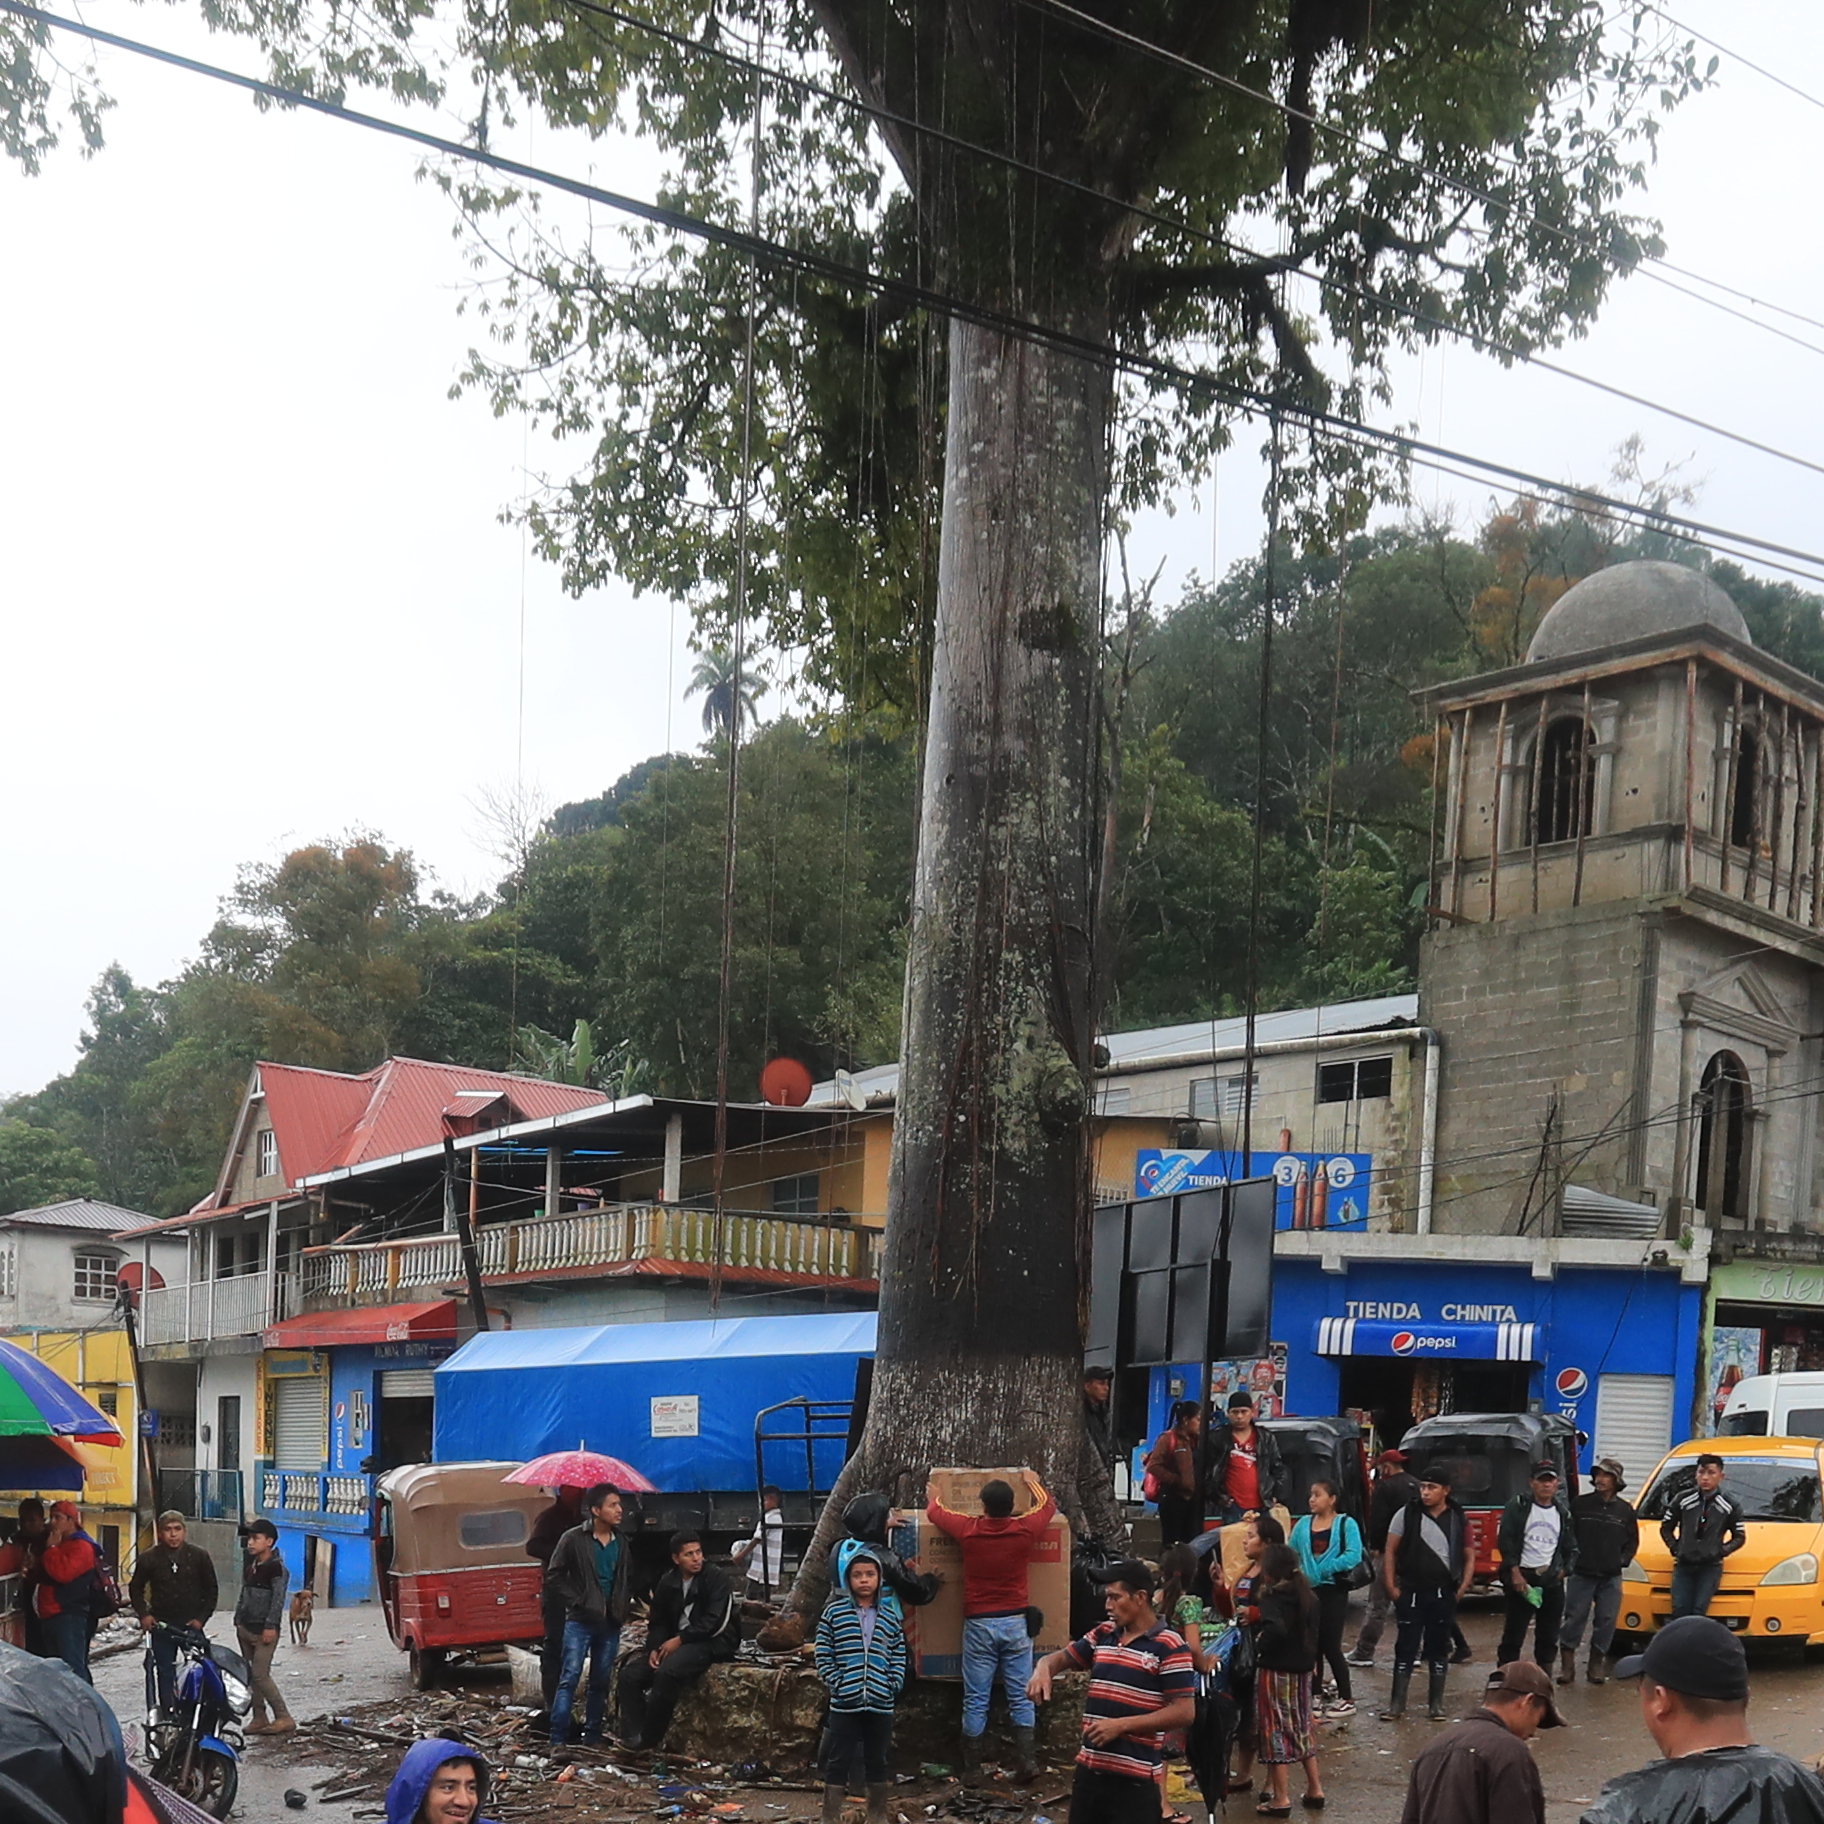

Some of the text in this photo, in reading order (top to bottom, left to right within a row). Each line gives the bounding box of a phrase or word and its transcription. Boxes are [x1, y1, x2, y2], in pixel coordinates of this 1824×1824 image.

[1187, 1175, 1228, 1187] TIENDA
[1346, 1301, 1518, 1322] TIENDA CHINITA
[1416, 1335, 1457, 1350] pepsi
[336, 1426, 345, 1469] pepsi
